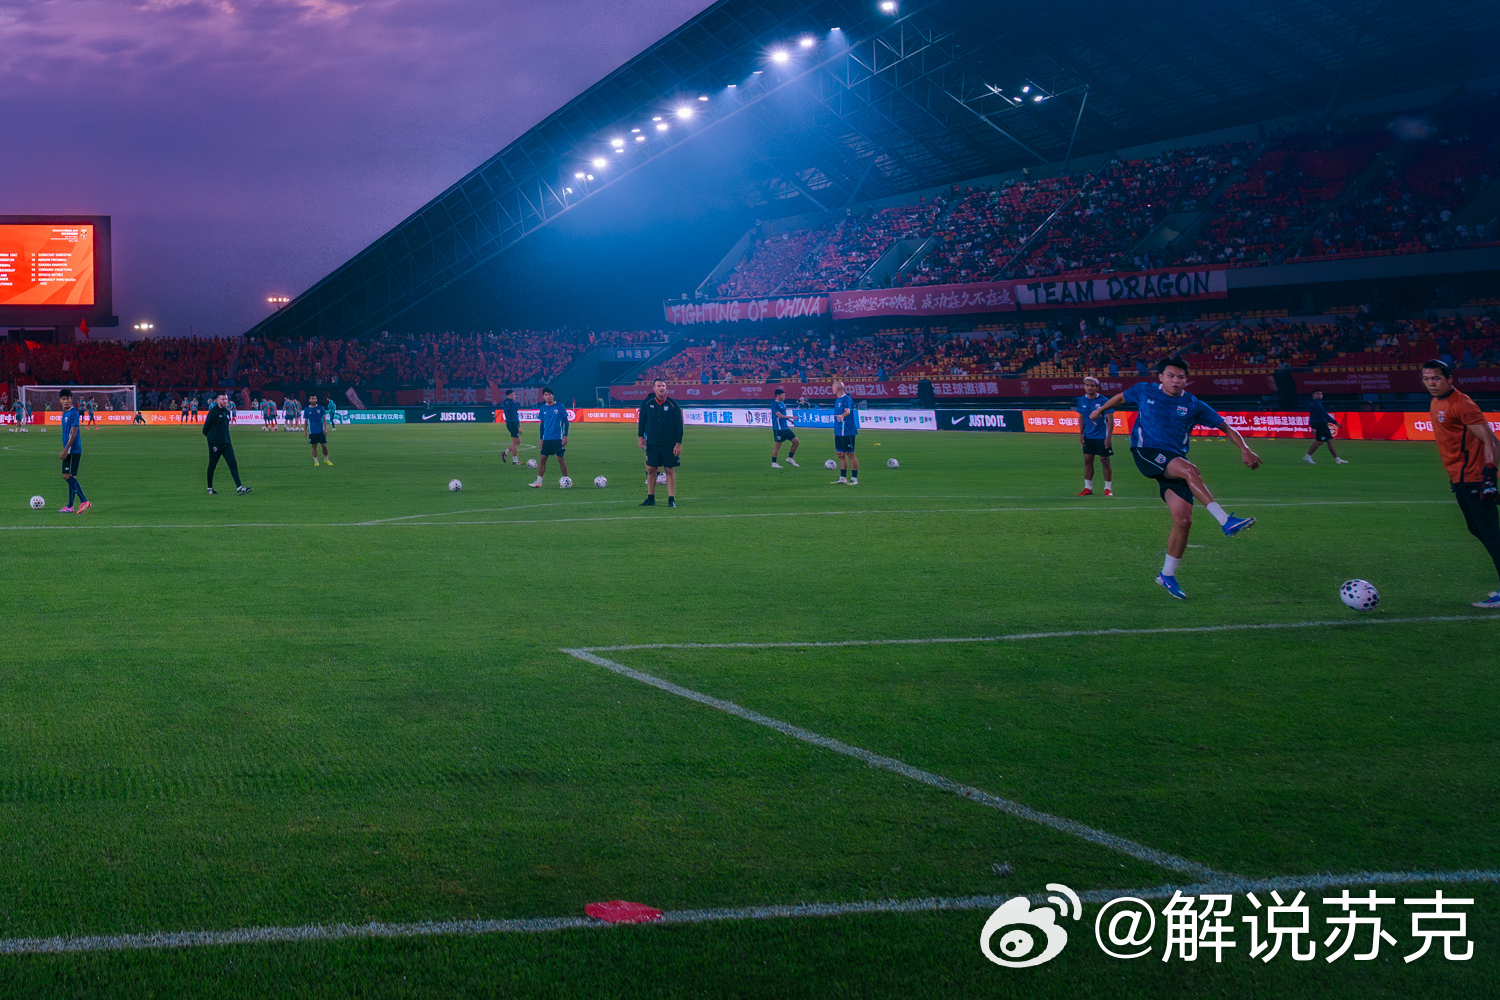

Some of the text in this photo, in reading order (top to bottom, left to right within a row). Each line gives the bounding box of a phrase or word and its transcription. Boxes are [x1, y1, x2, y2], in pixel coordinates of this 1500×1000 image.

[1026, 270, 1210, 306] TEAM DRAGON
[671, 295, 821, 326] FIGHTING OF CHINA
[1458, 376, 1487, 384] yuwell
[440, 412, 476, 421] JUST DO IT.
[969, 414, 1006, 427] JUST DO IT.
[1028, 417, 1079, 427] 中国平安 中国平
